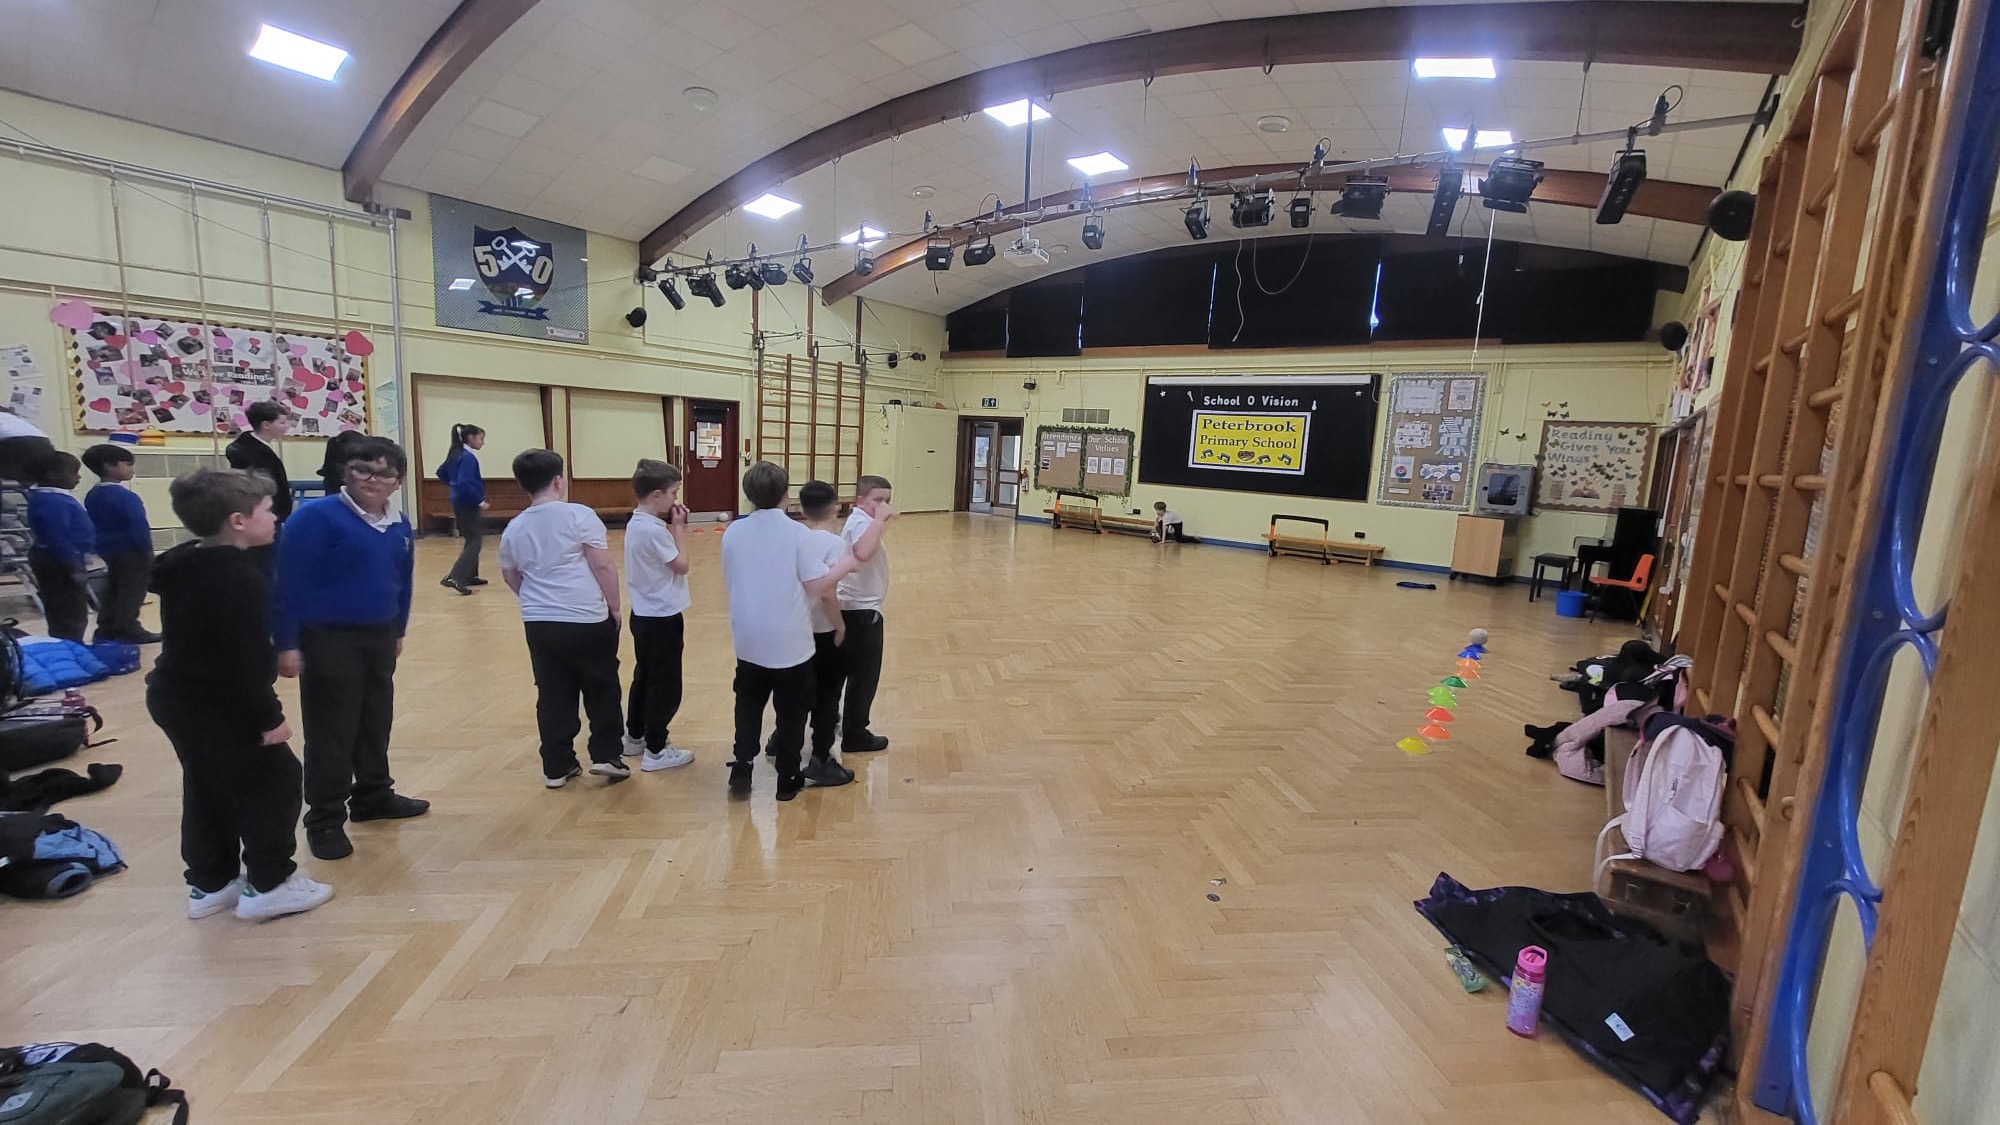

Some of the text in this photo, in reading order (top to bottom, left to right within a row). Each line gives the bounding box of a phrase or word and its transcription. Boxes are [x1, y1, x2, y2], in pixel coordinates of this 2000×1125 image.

[474, 246, 499, 277] 5
[182, 366, 200, 377] We
[1203, 395, 1240, 406] School
[1262, 395, 1299, 407] Vision
[1202, 418, 1296, 432] Peterbrook
[1087, 435, 1128, 445] Our School
[1200, 434, 1296, 450] Primary School
[1552, 429, 1613, 443] Reading
[1095, 444, 1119, 452] Values
[1560, 441, 1599, 452] Gives
[1547, 452, 1590, 465] Wings
